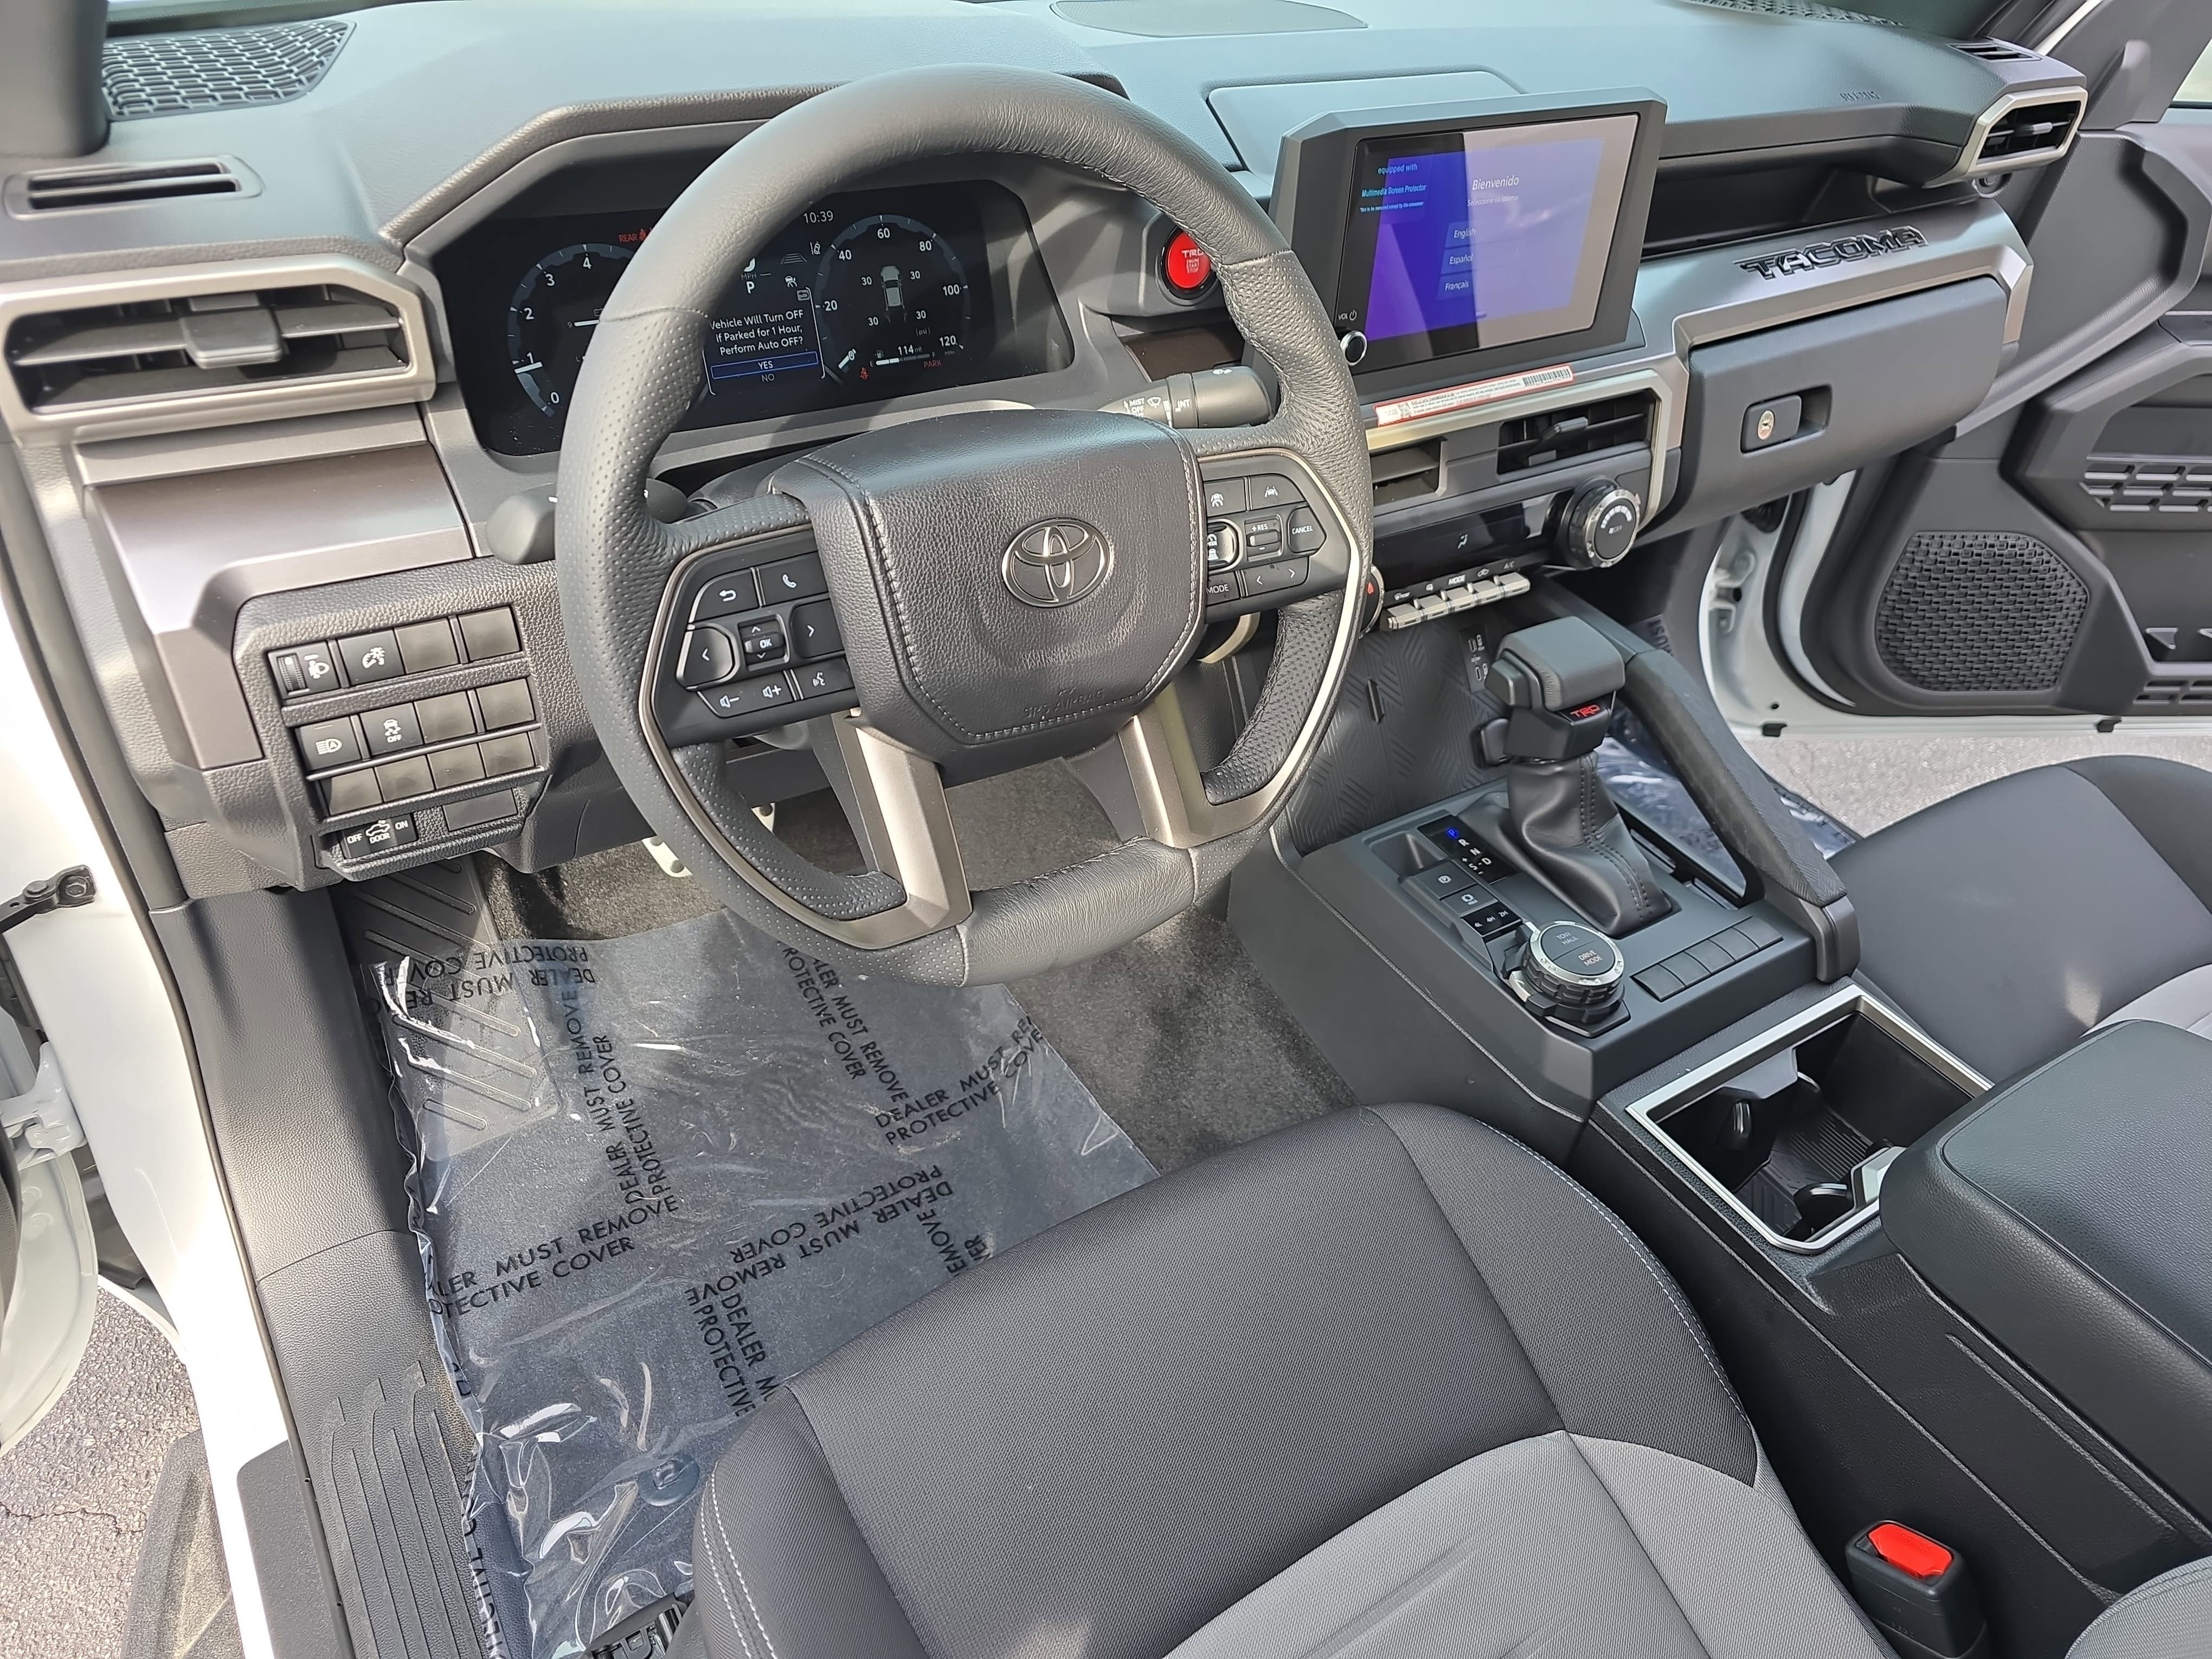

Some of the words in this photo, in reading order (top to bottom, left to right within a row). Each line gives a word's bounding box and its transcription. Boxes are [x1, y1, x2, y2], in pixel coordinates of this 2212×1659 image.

[1378, 164, 1404, 175] equipped
[1406, 163, 1417, 171] with
[1472, 175, 1519, 190] Bienvenido
[1361, 188, 1387, 197] Multimedia
[1388, 187, 1404, 195] Screen
[1405, 184, 1426, 193] Protector
[803, 211, 833, 223] 10:39
[619, 234, 638, 242] REAR
[877, 228, 890, 239] 60
[1454, 228, 1476, 239] English
[919, 241, 932, 251] 80
[839, 250, 852, 260] 40
[1733, 225, 1929, 280] TACOMA
[583, 257, 592, 269] 4
[1449, 254, 1474, 266] Español
[546, 273, 555, 286] 3
[861, 276, 872, 286] 30
[910, 271, 921, 280] 30
[746, 281, 755, 294] P
[943, 285, 960, 295] 100
[1445, 280, 1469, 291] Français
[825, 300, 838, 311] 20
[524, 308, 534, 320] 2
[710, 317, 743, 330] Vehicle
[744, 314, 762, 325] Will
[763, 313, 784, 323] Turn
[786, 310, 803, 320] OFF
[916, 310, 927, 320] 30
[868, 317, 879, 326] 30
[716, 334, 722, 343] if
[724, 329, 755, 342] Parked
[757, 328, 770, 337] for
[772, 326, 776, 335] 1
[719, 344, 756, 356] Perform
[758, 341, 779, 351] Auto
[781, 336, 803, 348] OFF?
[939, 335, 956, 347] 120
[848, 350, 855, 361] 0
[898, 344, 914, 356] 114
[526, 352, 535, 363] 1
[758, 361, 773, 370] YES
[923, 359, 942, 369] PARK
[761, 374, 775, 382] NO
[550, 393, 560, 404] 0
[1129, 397, 1144, 407] MIST
[1177, 398, 1190, 408] INT
[1131, 406, 1144, 414] OFF
[1292, 525, 1313, 534] CANCEL
[1504, 561, 1514, 569] A/C
[1448, 575, 1466, 586] MODE
[1206, 584, 1229, 594] MODE
[760, 638, 773, 648] OK
[1570, 704, 1600, 717] TRD
[387, 734, 402, 743] OFF
[395, 820, 408, 830] ON
[347, 833, 363, 844] OFF
[369, 832, 390, 844] DOOR
[1469, 847, 1481, 856] N
[1555, 931, 1571, 940] TOW
[1561, 937, 1579, 946] HAUL
[473, 946, 588, 970] PROTECTIVE
[1578, 950, 1598, 961] DRIVE
[1583, 955, 1603, 967] MODE
[529, 968, 595, 986] DEALER
[449, 973, 513, 1001] MUST
[782, 947, 837, 1028] ROTECTIVE
[828, 1032, 866, 1080] COVER
[562, 989, 595, 1075] REMOVE
[832, 995, 869, 1036] MUST
[860, 1041, 909, 1102] REMOVE
[593, 1034, 627, 1094] COVER
[875, 1089, 950, 1129] DEALER
[960, 1046, 1004, 1092] MUST
[584, 1086, 615, 1132] MUST
[886, 1080, 1001, 1145] PROTECTIVE
[615, 1098, 672, 1196] PROTECTIVE
[606, 1141, 644, 1204] DEALER
[814, 1164, 943, 1229] PROTECTIVE
[871, 1180, 954, 1223] DEALER
[496, 1237, 563, 1277] MUST
[578, 1196, 679, 1241] REMOVE
[730, 1221, 807, 1264] COVER
[798, 1219, 860, 1259] MUST
[916, 1208, 967, 1274] EMOVE
[552, 1237, 634, 1278] COVER
[684, 1252, 786, 1307] REMOVE
[720, 1293, 766, 1367] DEALER
[693, 1303, 756, 1417] PROTECTIVE
